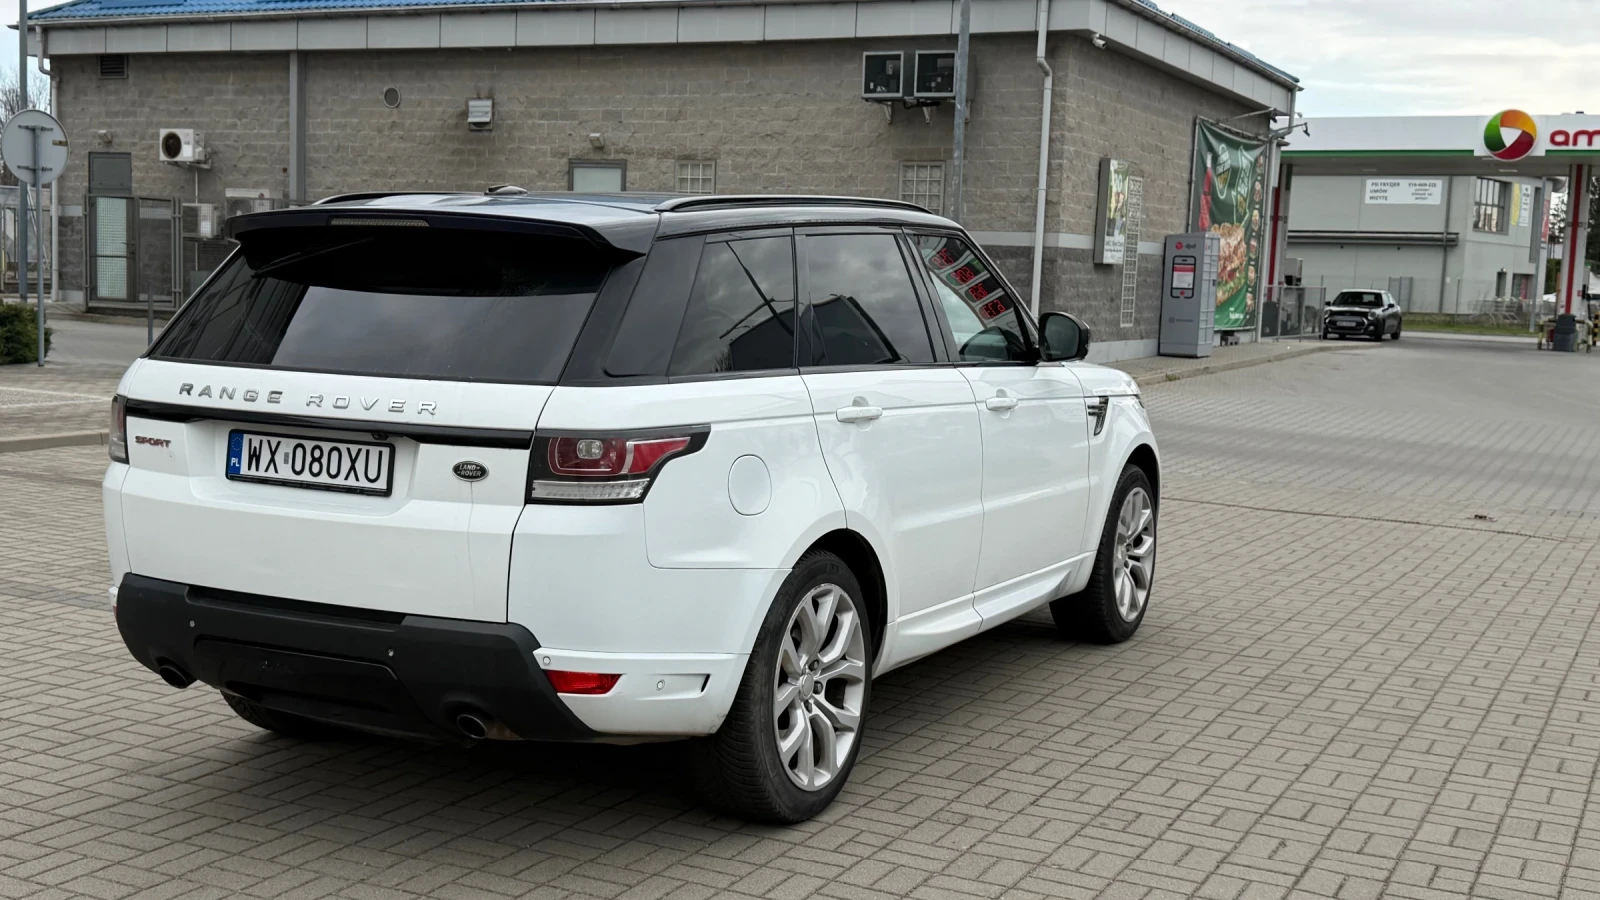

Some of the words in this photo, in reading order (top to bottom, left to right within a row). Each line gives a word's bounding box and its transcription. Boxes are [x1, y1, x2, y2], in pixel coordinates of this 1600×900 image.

[178, 382, 283, 404] RANGE
[305, 393, 438, 415] ROVER
[134, 435, 172, 448] SPORT
[230, 457, 240, 467] PL
